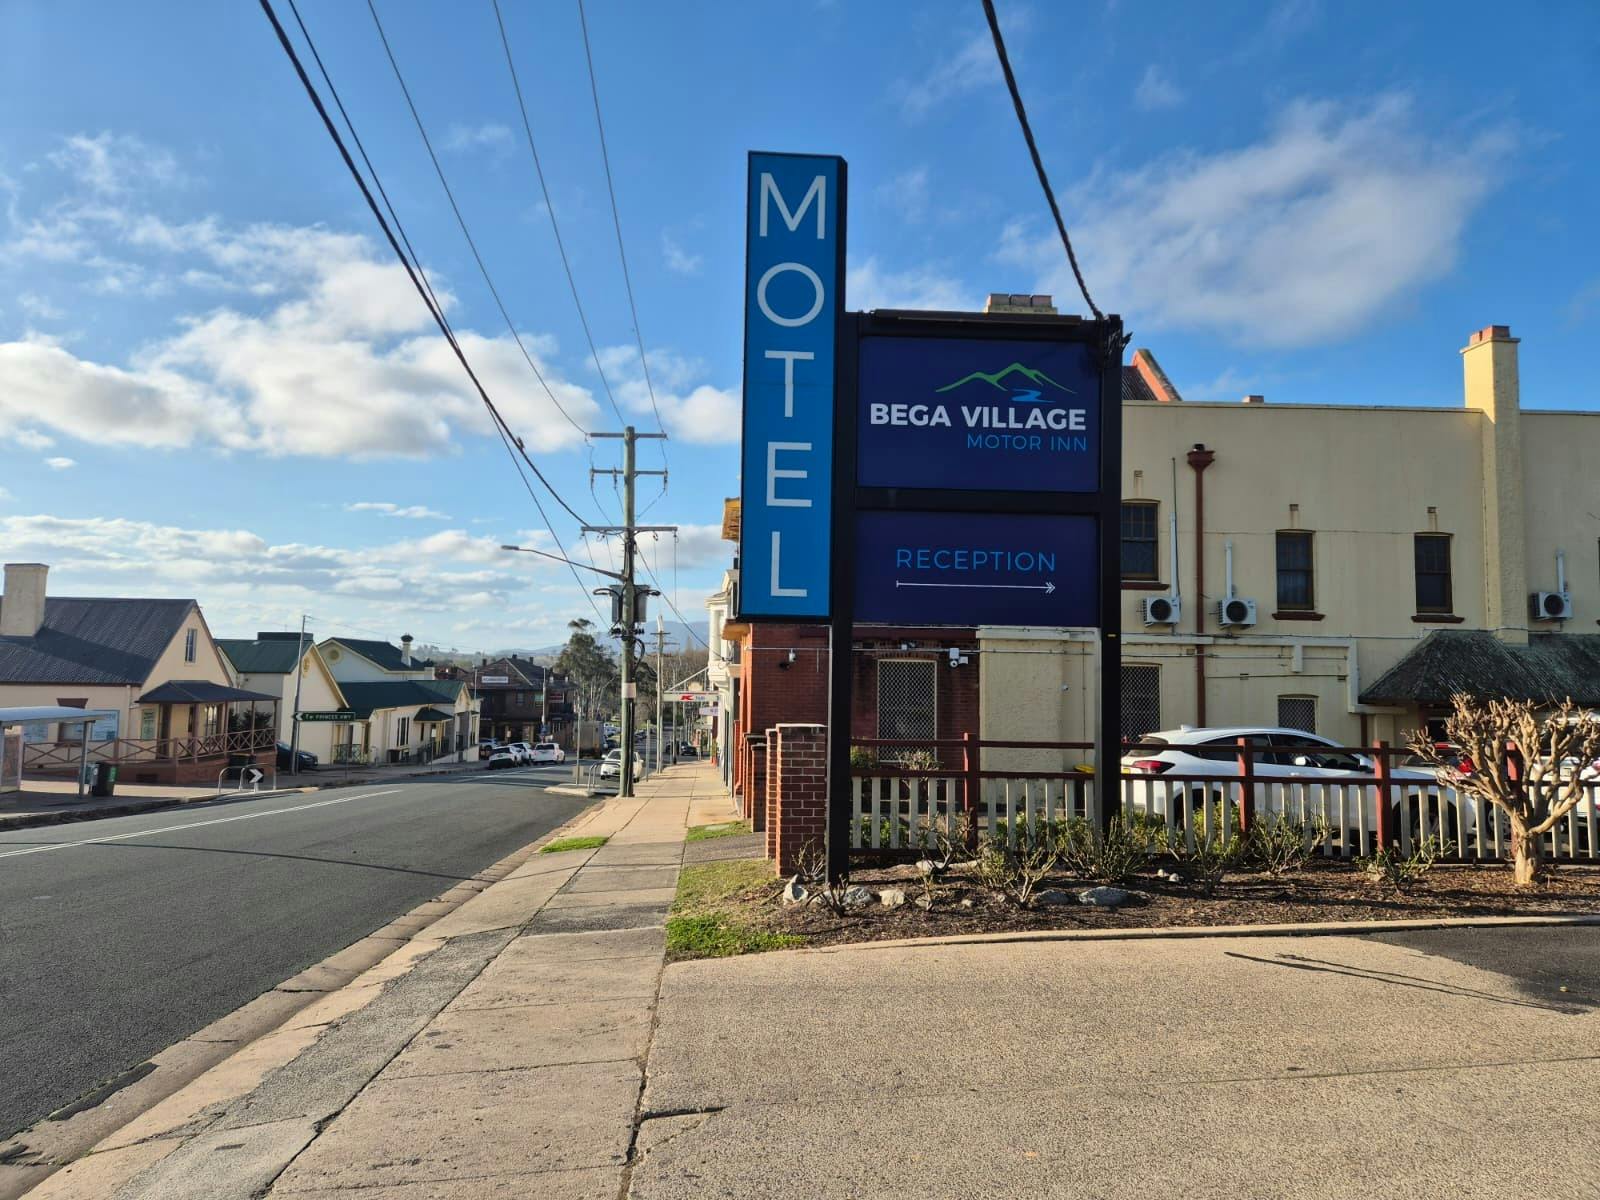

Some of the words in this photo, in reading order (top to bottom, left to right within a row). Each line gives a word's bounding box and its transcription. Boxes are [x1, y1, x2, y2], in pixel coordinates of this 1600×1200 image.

[757, 172, 826, 597] MOTEL
[870, 403, 952, 427] BEGA
[961, 406, 1087, 430] VILLAGE
[967, 434, 1041, 450] MOTOR
[1051, 436, 1087, 451] INN
[896, 549, 1056, 572] RECEPTION
